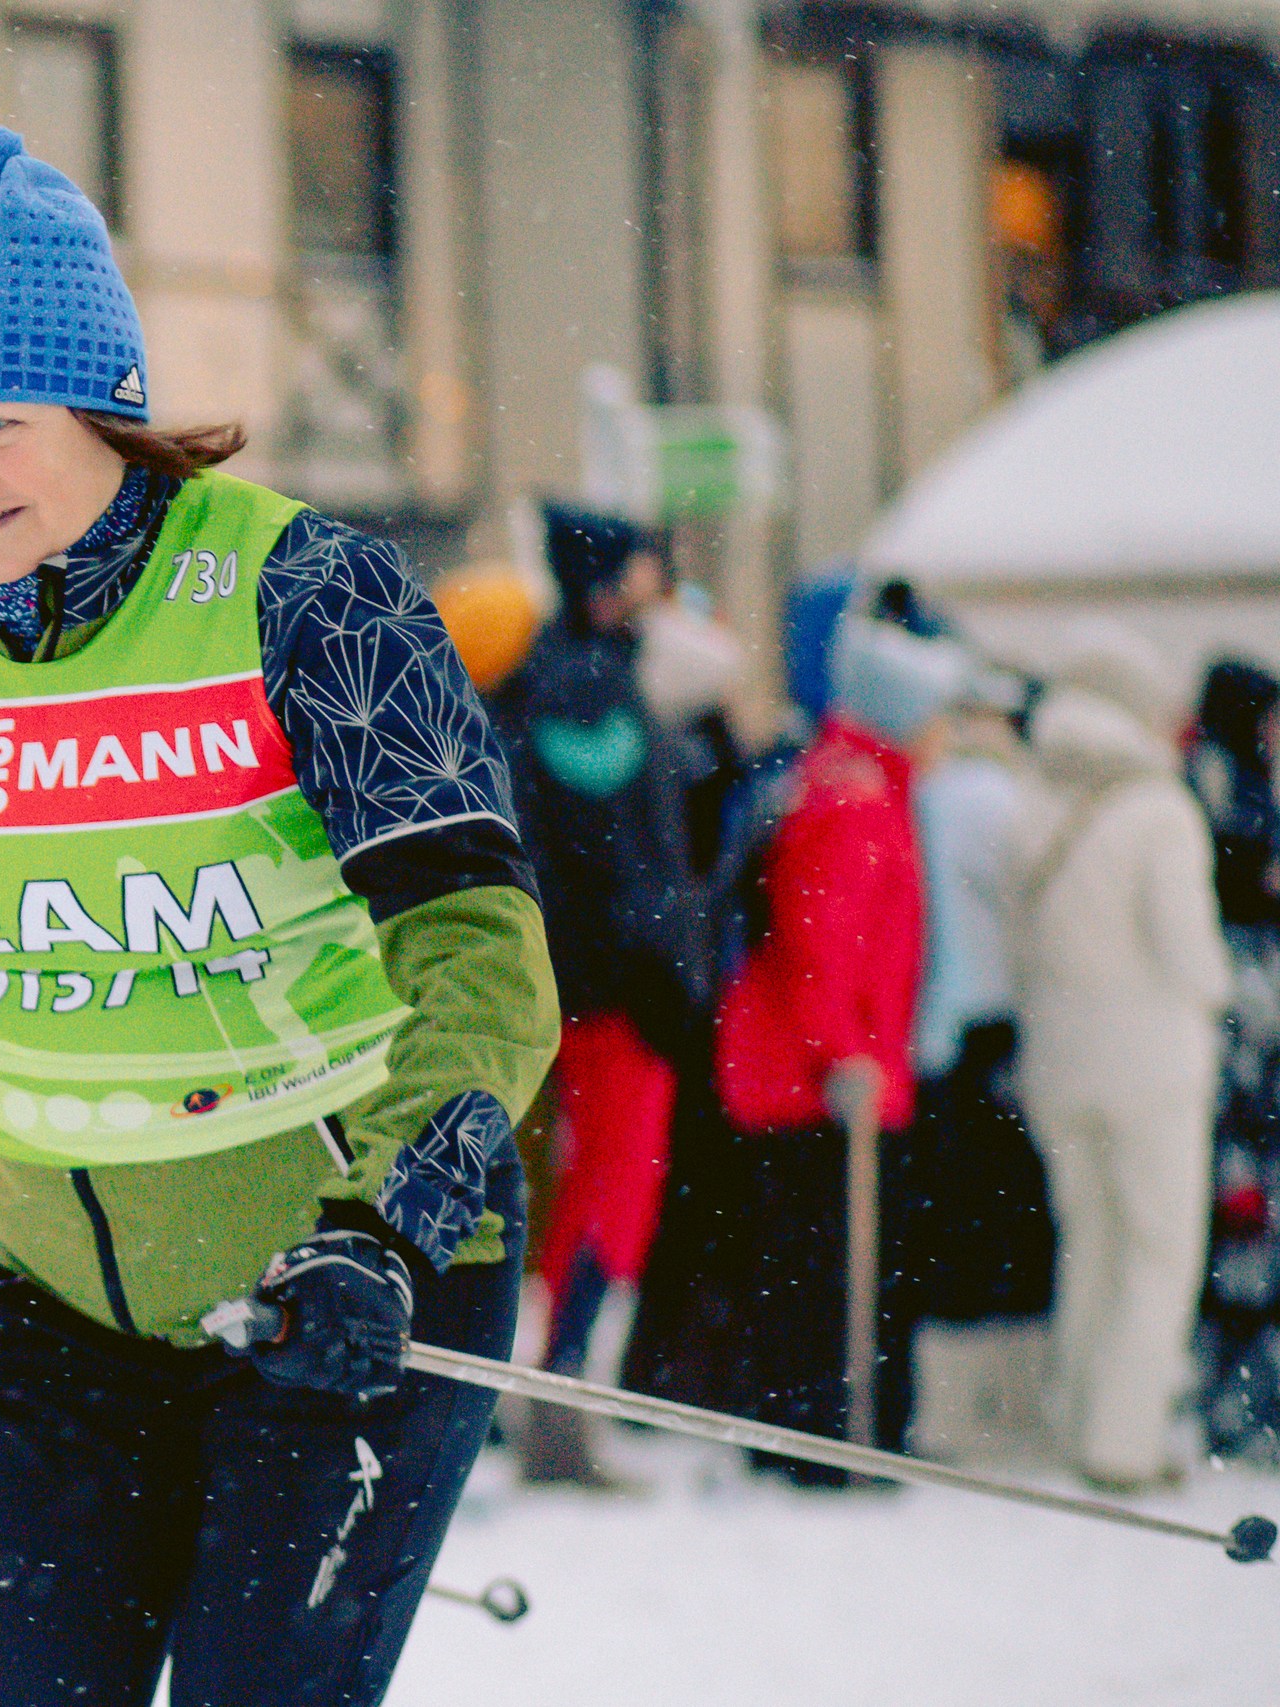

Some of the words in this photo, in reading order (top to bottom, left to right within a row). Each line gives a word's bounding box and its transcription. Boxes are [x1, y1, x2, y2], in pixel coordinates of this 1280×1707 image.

[164, 549, 237, 603] 730
[248, 1083, 278, 1101] IBU
[282, 1064, 326, 1090] World
[329, 1052, 355, 1070] Cup
